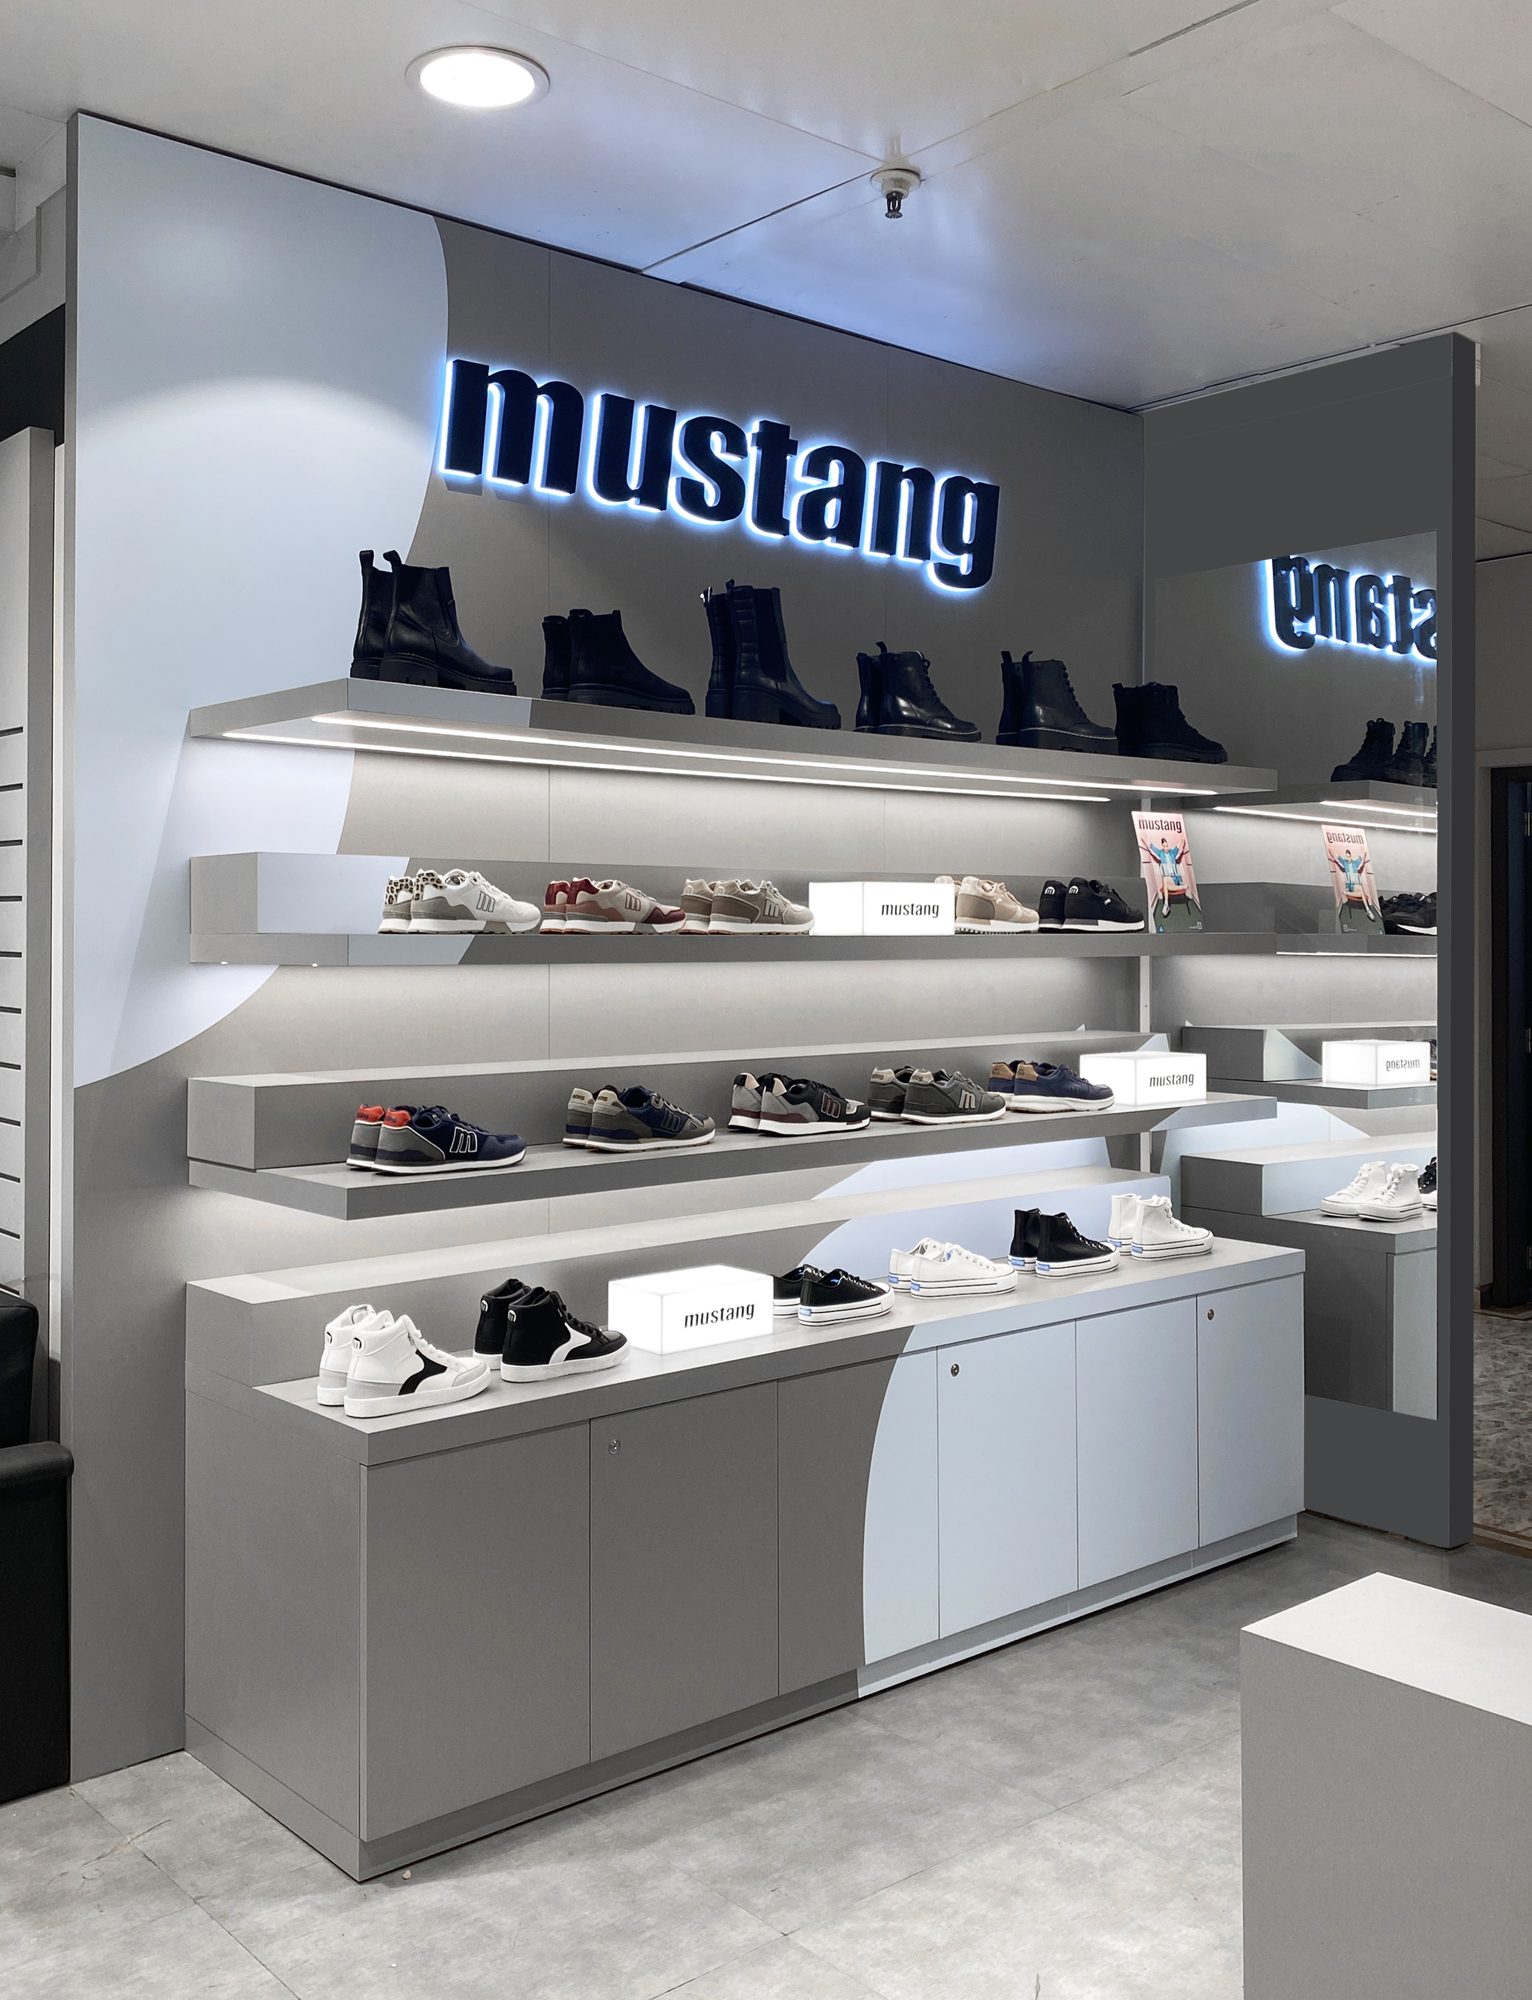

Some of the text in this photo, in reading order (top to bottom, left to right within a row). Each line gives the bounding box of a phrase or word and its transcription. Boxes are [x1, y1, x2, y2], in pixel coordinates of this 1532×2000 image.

[443, 358, 1001, 589] mustang
[1138, 819, 1183, 833] mustang
[881, 903, 940, 919] mustang
[1149, 1073, 1195, 1088] mustang
[684, 1303, 755, 1329] mustang
